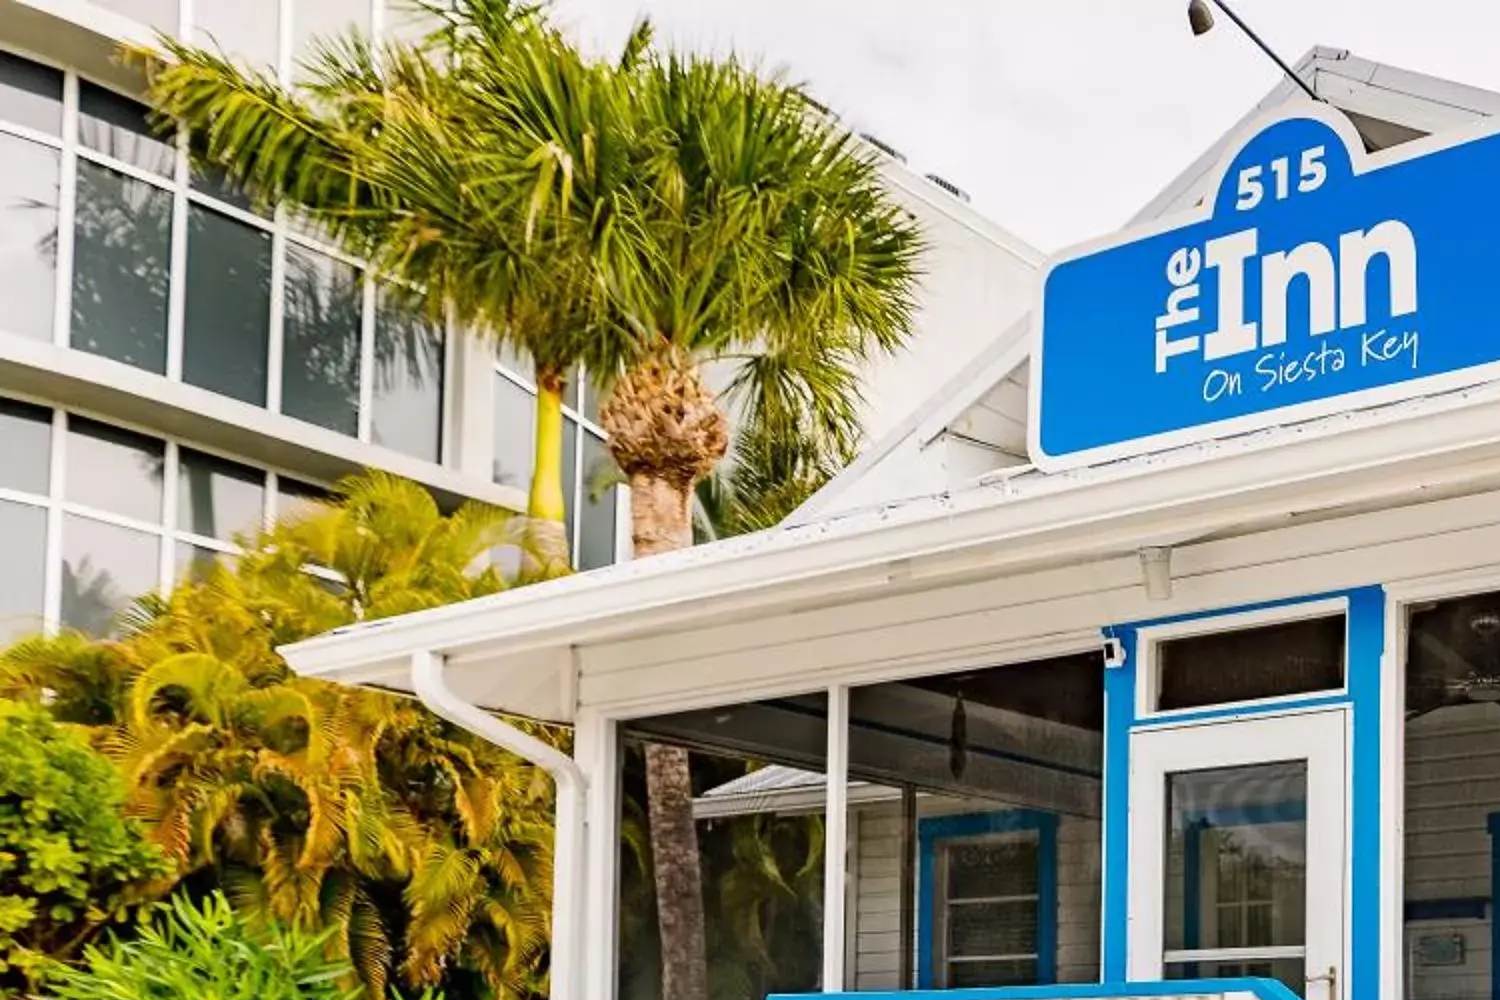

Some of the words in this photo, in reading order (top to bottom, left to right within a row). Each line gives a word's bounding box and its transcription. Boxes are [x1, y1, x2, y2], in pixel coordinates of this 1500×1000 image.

[1236, 145, 1327, 212] 515
[1155, 246, 1201, 374] The
[1203, 219, 1418, 362] Inn
[1203, 369, 1242, 402] On
[1255, 340, 1345, 391] Siesta
[1361, 329, 1419, 369] Key
